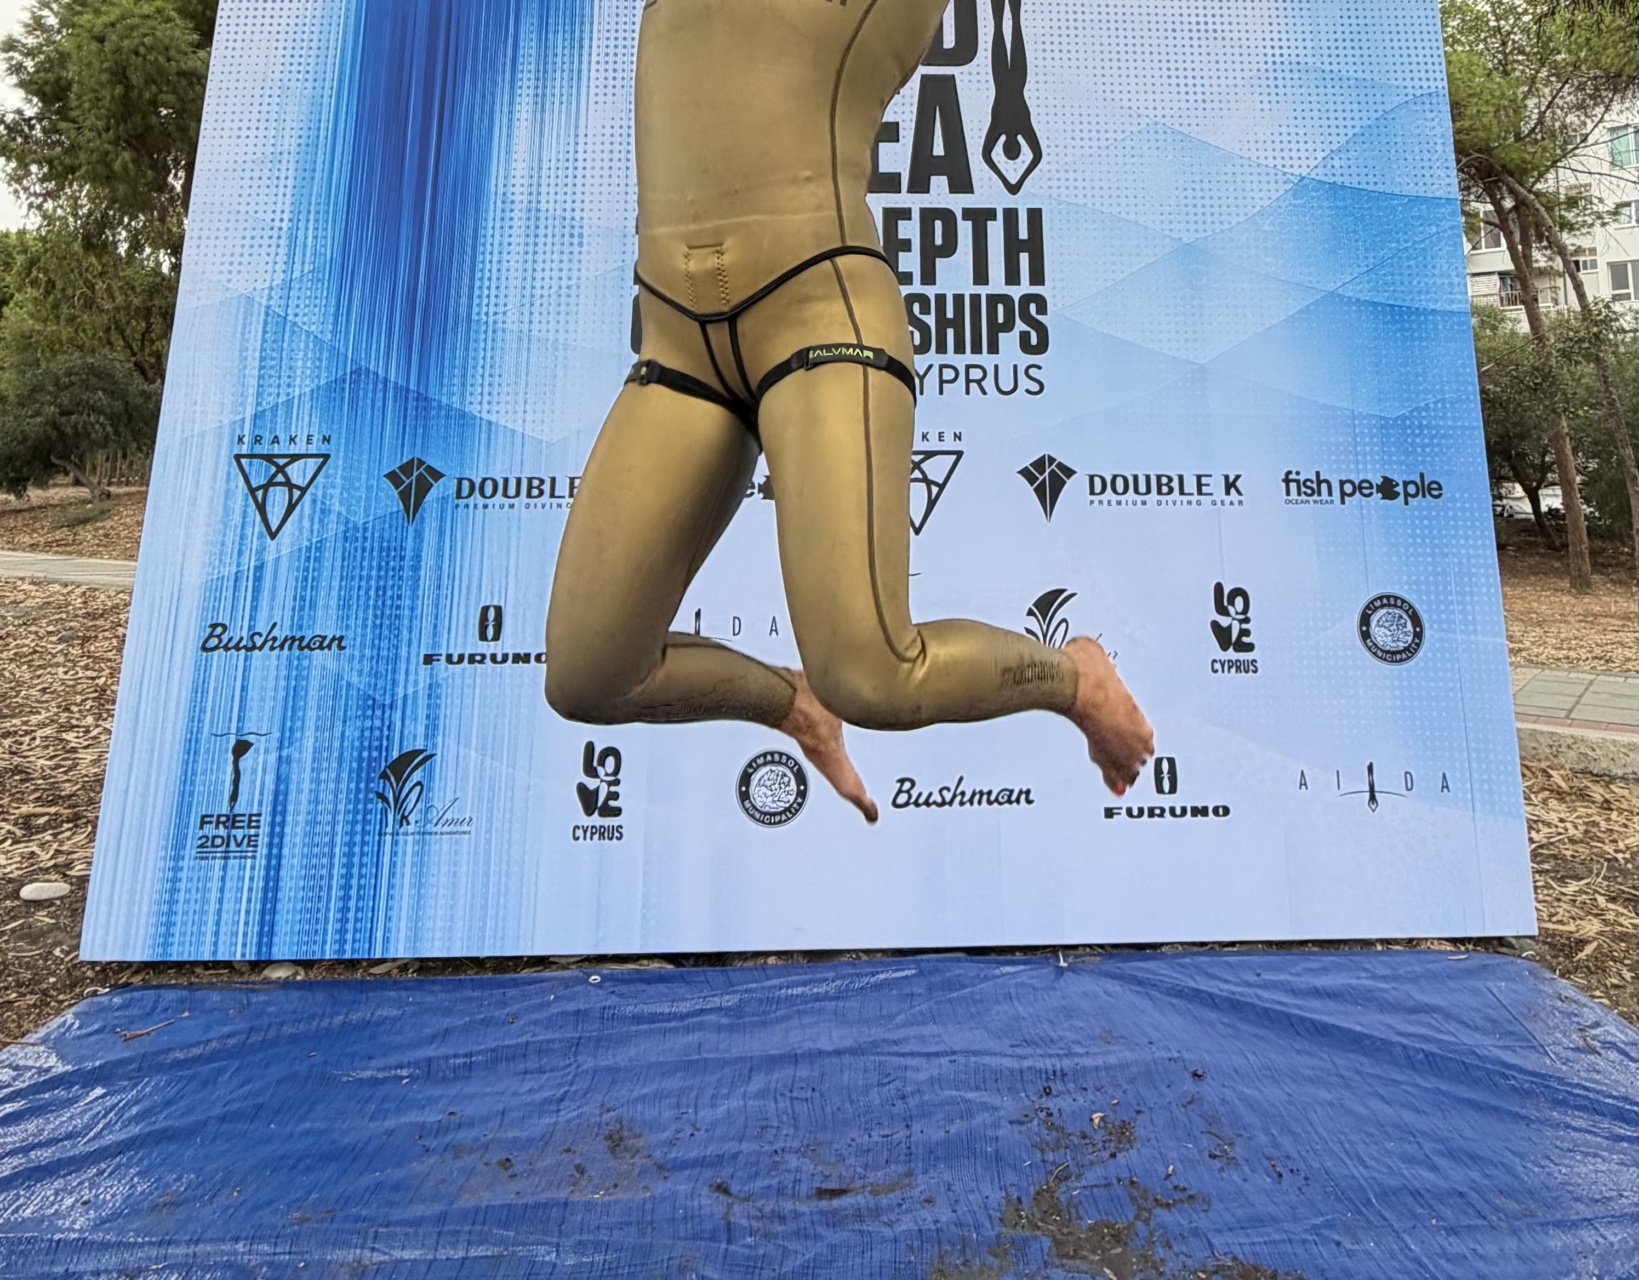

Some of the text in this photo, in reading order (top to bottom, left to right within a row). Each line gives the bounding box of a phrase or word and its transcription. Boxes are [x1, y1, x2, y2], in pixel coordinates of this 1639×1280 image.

[882, 207, 1046, 286] EPTH
[914, 363, 1045, 396] YPRUS
[237, 434, 332, 446] KRAKEN
[921, 431, 962, 442] KEN
[1086, 473, 1244, 496] DOUBLE K
[1281, 470, 1333, 497] fish
[1089, 499, 1244, 507] PREMIUM DIVING GEAR
[1284, 498, 1335, 506] OCEAN WEAR
[1365, 597, 1414, 615] LIMASSOL
[200, 622, 347, 654] Bushman
[1365, 637, 1420, 661] MUNICIPALITY
[1210, 658, 1259, 674] CYPRUS
[747, 753, 800, 773] LIMASSOL
[891, 775, 1036, 809] Bushman
[743, 797, 803, 823] MUNICIPALITY
[1103, 804, 1232, 819] FURUNO
[198, 813, 262, 830] FREE
[196, 834, 260, 849] 2DIVE
[571, 824, 624, 841] CYPRUS
